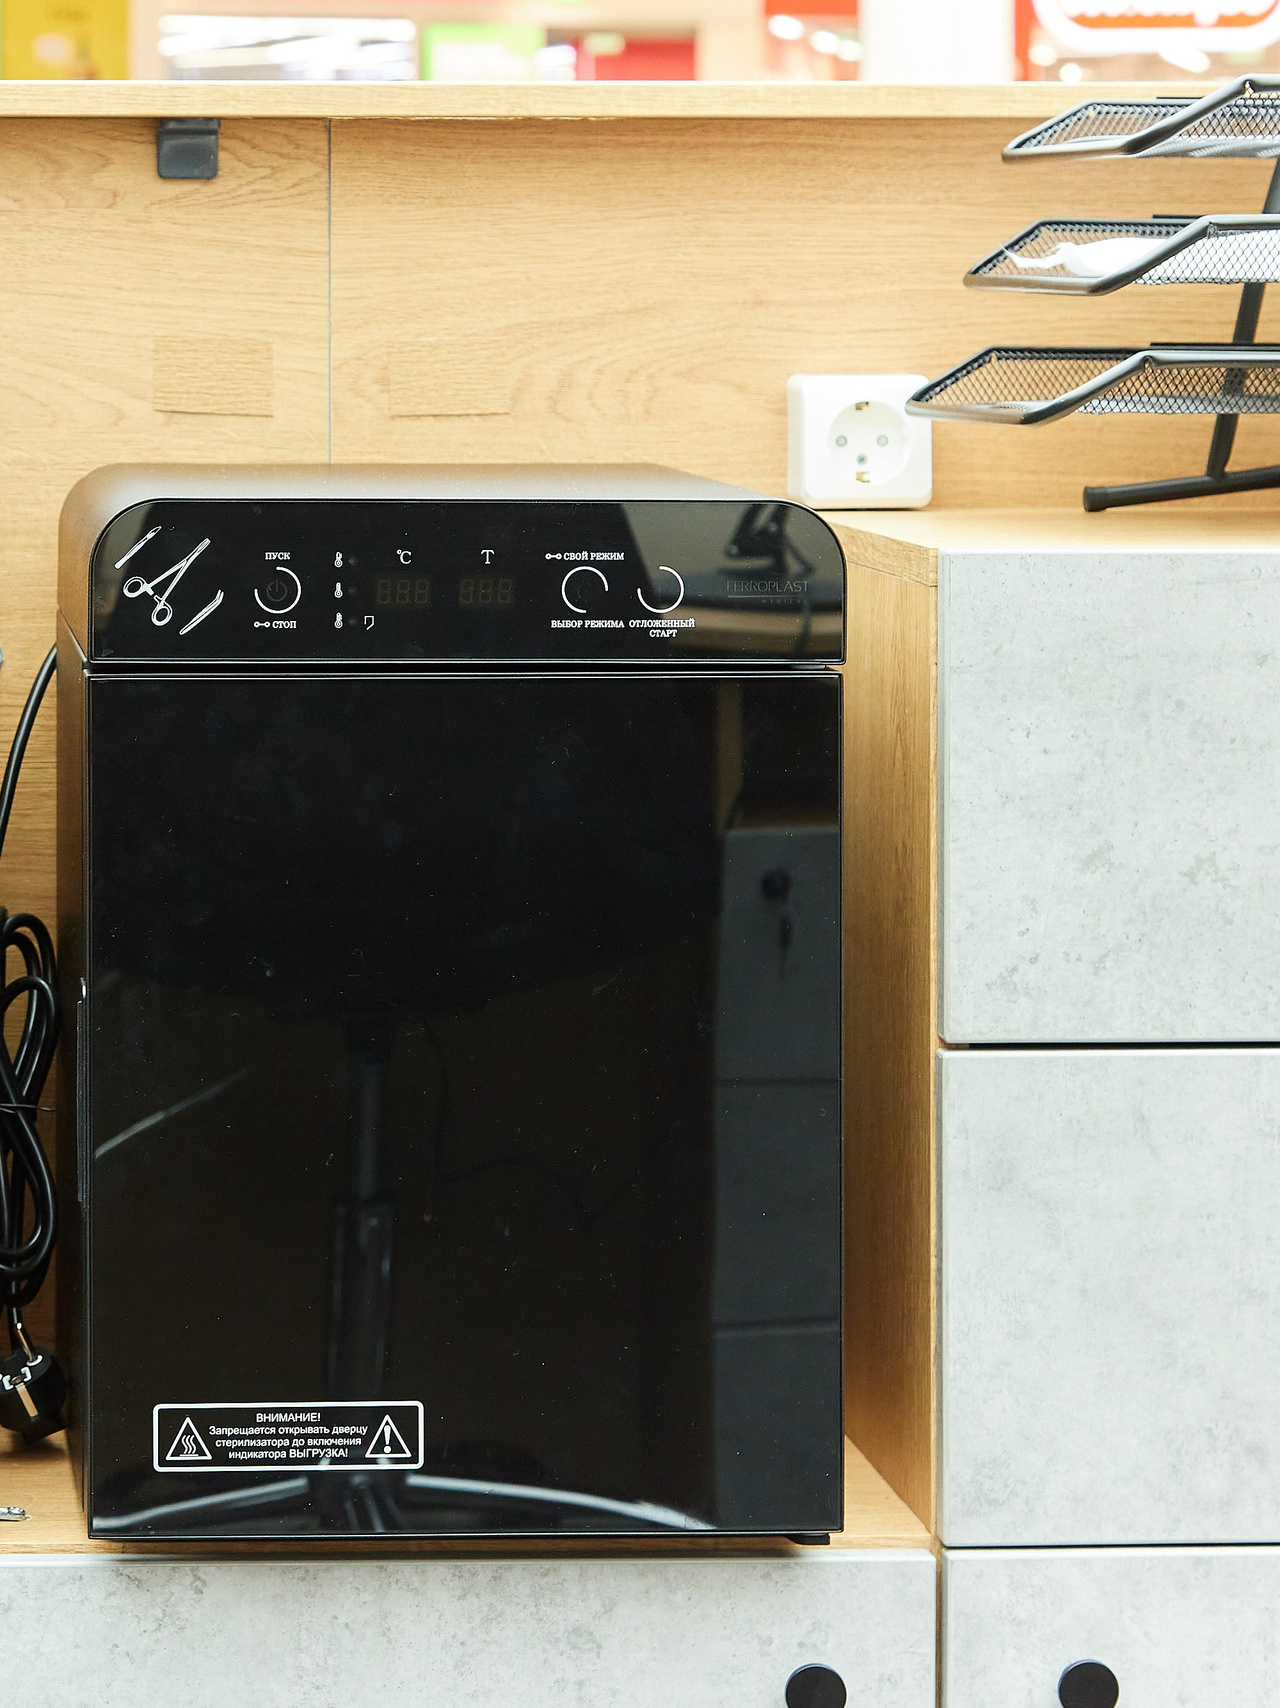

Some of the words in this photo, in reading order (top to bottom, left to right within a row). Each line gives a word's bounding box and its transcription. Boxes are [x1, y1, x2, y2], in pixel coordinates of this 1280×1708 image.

[264, 551, 291, 561] ПУСК
[563, 550, 589, 561] СВОЙ
[589, 552, 625, 561] РЕЖИМ
[726, 580, 808, 593] FERROPLAST
[272, 620, 297, 629] СТОП
[550, 619, 584, 628] ВЫБОР
[584, 619, 625, 628] РЕЖИМА
[628, 617, 696, 628] ОТЛОЖЕННЫЙ
[649, 629, 678, 638] СТАРТ
[256, 1412, 321, 1423] ВНИМАНИЕ!
[208, 1425, 276, 1437] Запрещается
[277, 1426, 330, 1437] открывать
[331, 1425, 368, 1436] дверцу
[215, 1438, 290, 1449] стерилизатора
[291, 1438, 306, 1448] до
[307, 1437, 362, 1446] включения
[228, 1450, 287, 1461] индикатора
[289, 1447, 348, 1459] ВЫГРУЗКА!
